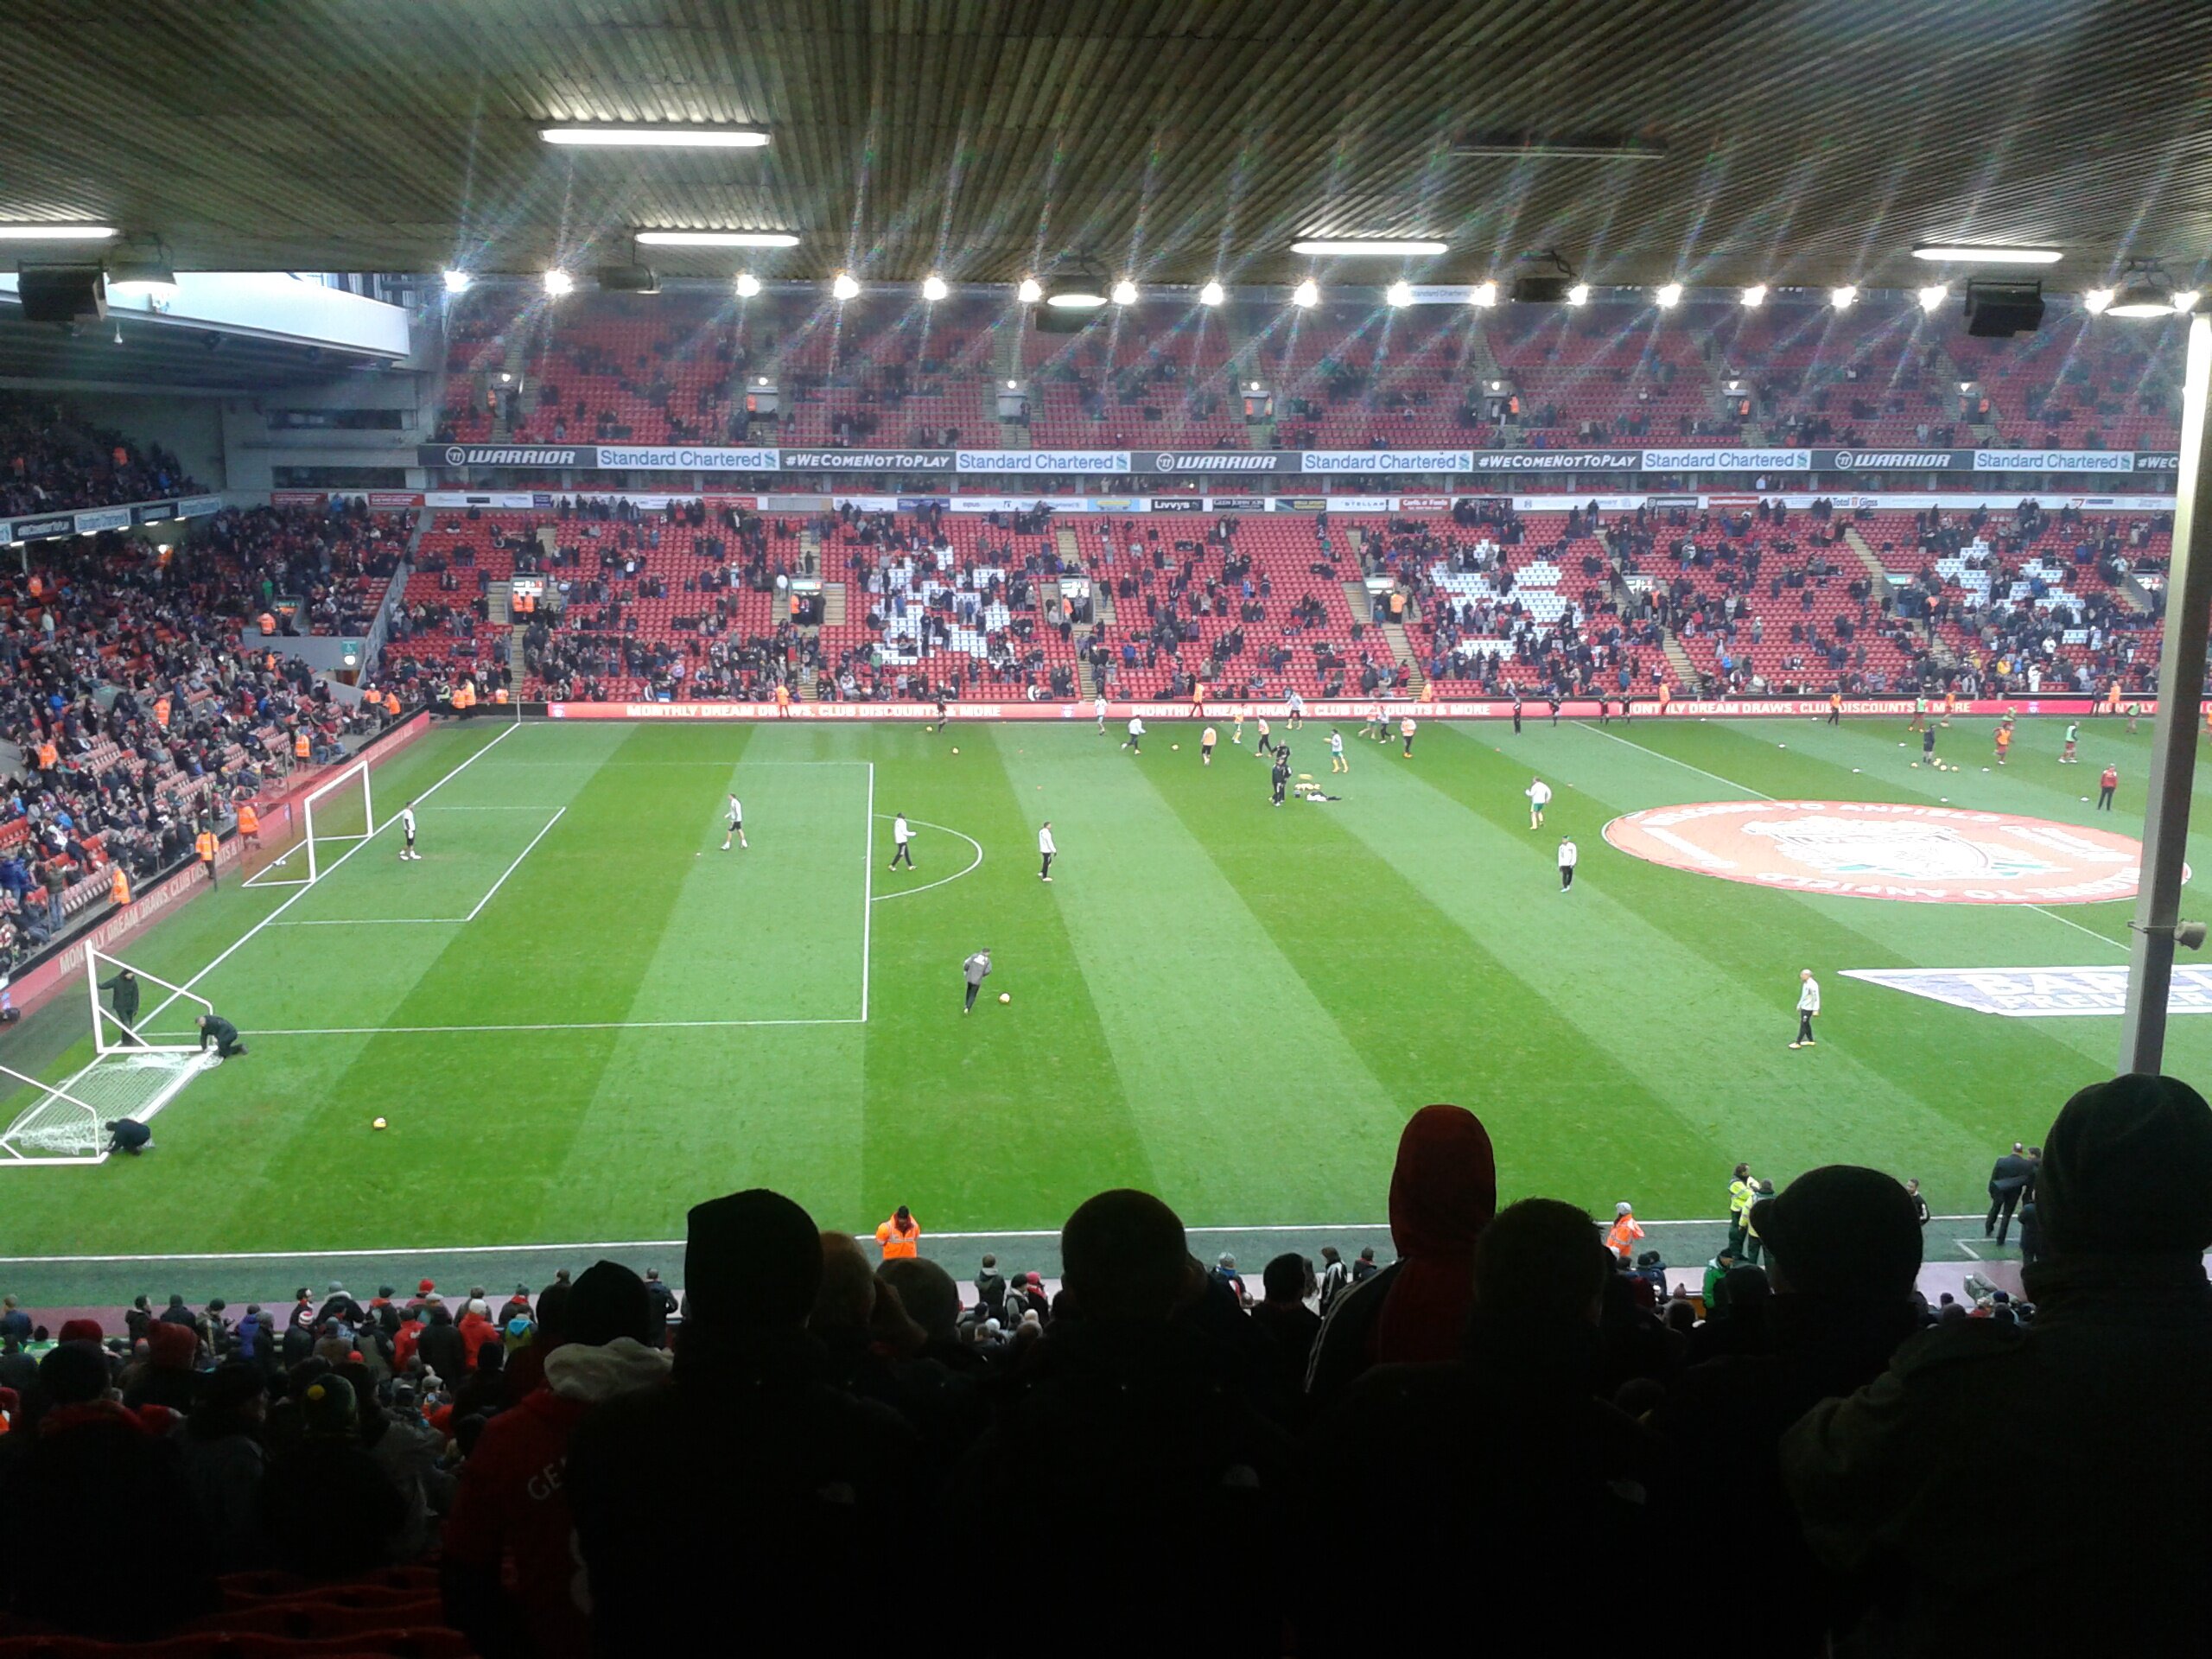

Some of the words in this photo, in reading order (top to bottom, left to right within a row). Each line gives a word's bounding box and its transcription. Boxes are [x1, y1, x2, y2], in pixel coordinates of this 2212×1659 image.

[468, 450, 575, 466] WARRIOR
[601, 449, 677, 467] Standard
[682, 449, 762, 467] Chartered
[959, 454, 1032, 469] Standard
[1033, 454, 1114, 470] Chartered
[1176, 455, 1277, 469] WARRIOR
[1305, 454, 1376, 469] Standard
[1379, 454, 1457, 470] Chartered
[1645, 453, 1715, 467] Standard
[1718, 452, 1795, 468] Chartered
[1854, 454, 1952, 467] WARRIOR
[1977, 454, 2044, 468] Standard
[2046, 454, 2119, 469] Chartered
[1833, 496, 1850, 507] Total
[626, 704, 698, 716] MONTHLY
[701, 704, 753, 716] DREAM
[818, 704, 855, 716] CLUB
[959, 704, 1001, 717] MORE
[1314, 704, 1351, 715] CLUB
[1354, 704, 1433, 715] DIOUNTS
[1450, 704, 1491, 715] MORE
[1688, 702, 1738, 714] DREAM
[1838, 702, 1916, 713] DISCOUNTS
[1933, 702, 1971, 713] MRE
[107, 906, 139, 940] DREAM
[170, 872, 192, 897] CLUB
